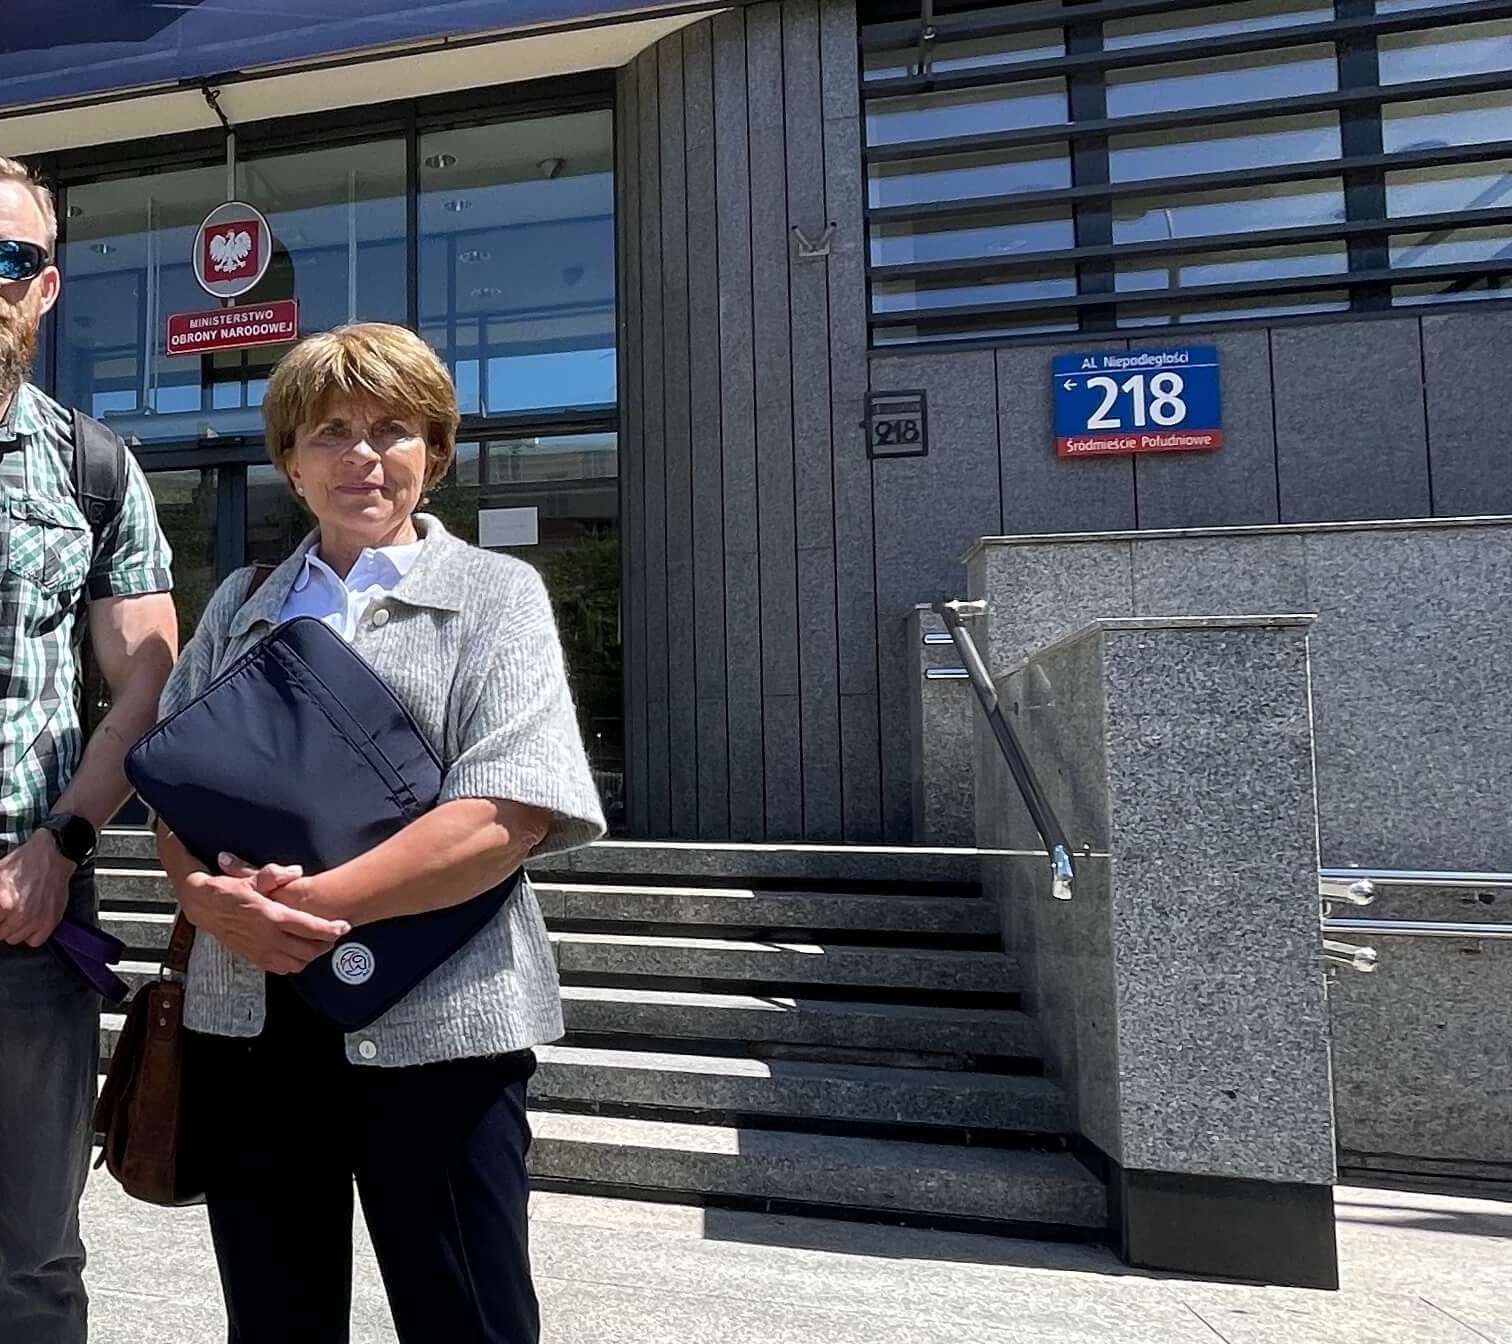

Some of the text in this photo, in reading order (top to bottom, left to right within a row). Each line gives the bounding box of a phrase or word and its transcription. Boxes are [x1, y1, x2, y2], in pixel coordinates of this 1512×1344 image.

[189, 309, 274, 329] MINISTERSTWO
[171, 321, 293, 346] OBRONY NARODOWEJ
[1103, 350, 1189, 368] Niepodległości
[1086, 371, 1187, 430] 218
[875, 419, 920, 445] 218
[1066, 433, 1212, 453] Śródmieście Południowe
